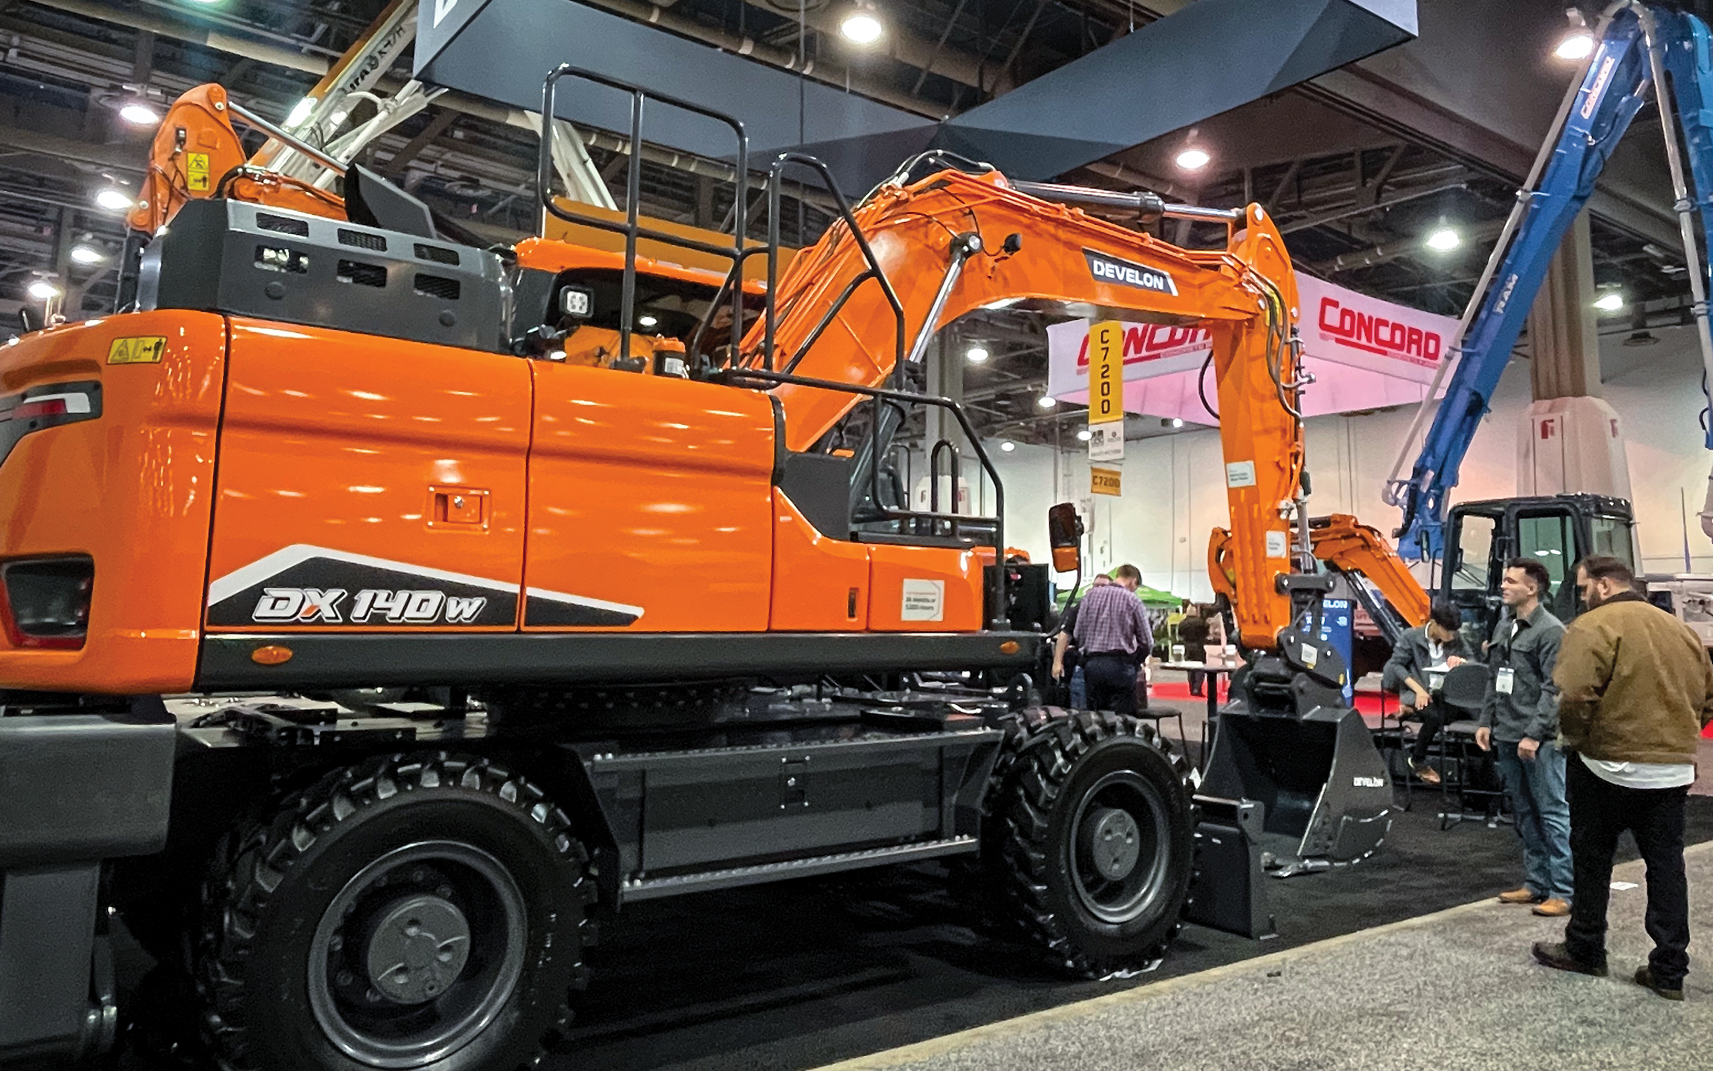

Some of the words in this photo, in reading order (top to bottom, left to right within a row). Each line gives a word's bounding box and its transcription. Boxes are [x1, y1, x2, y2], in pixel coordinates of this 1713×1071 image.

[1092, 260, 1164, 290] DEVELON
[1492, 273, 1519, 314] RAM
[1318, 296, 1441, 361] CONCORD
[1100, 329, 1110, 415] C7200
[1092, 475, 1121, 488] C7200
[252, 587, 348, 622] DX
[1353, 776, 1384, 787] DEVELON
